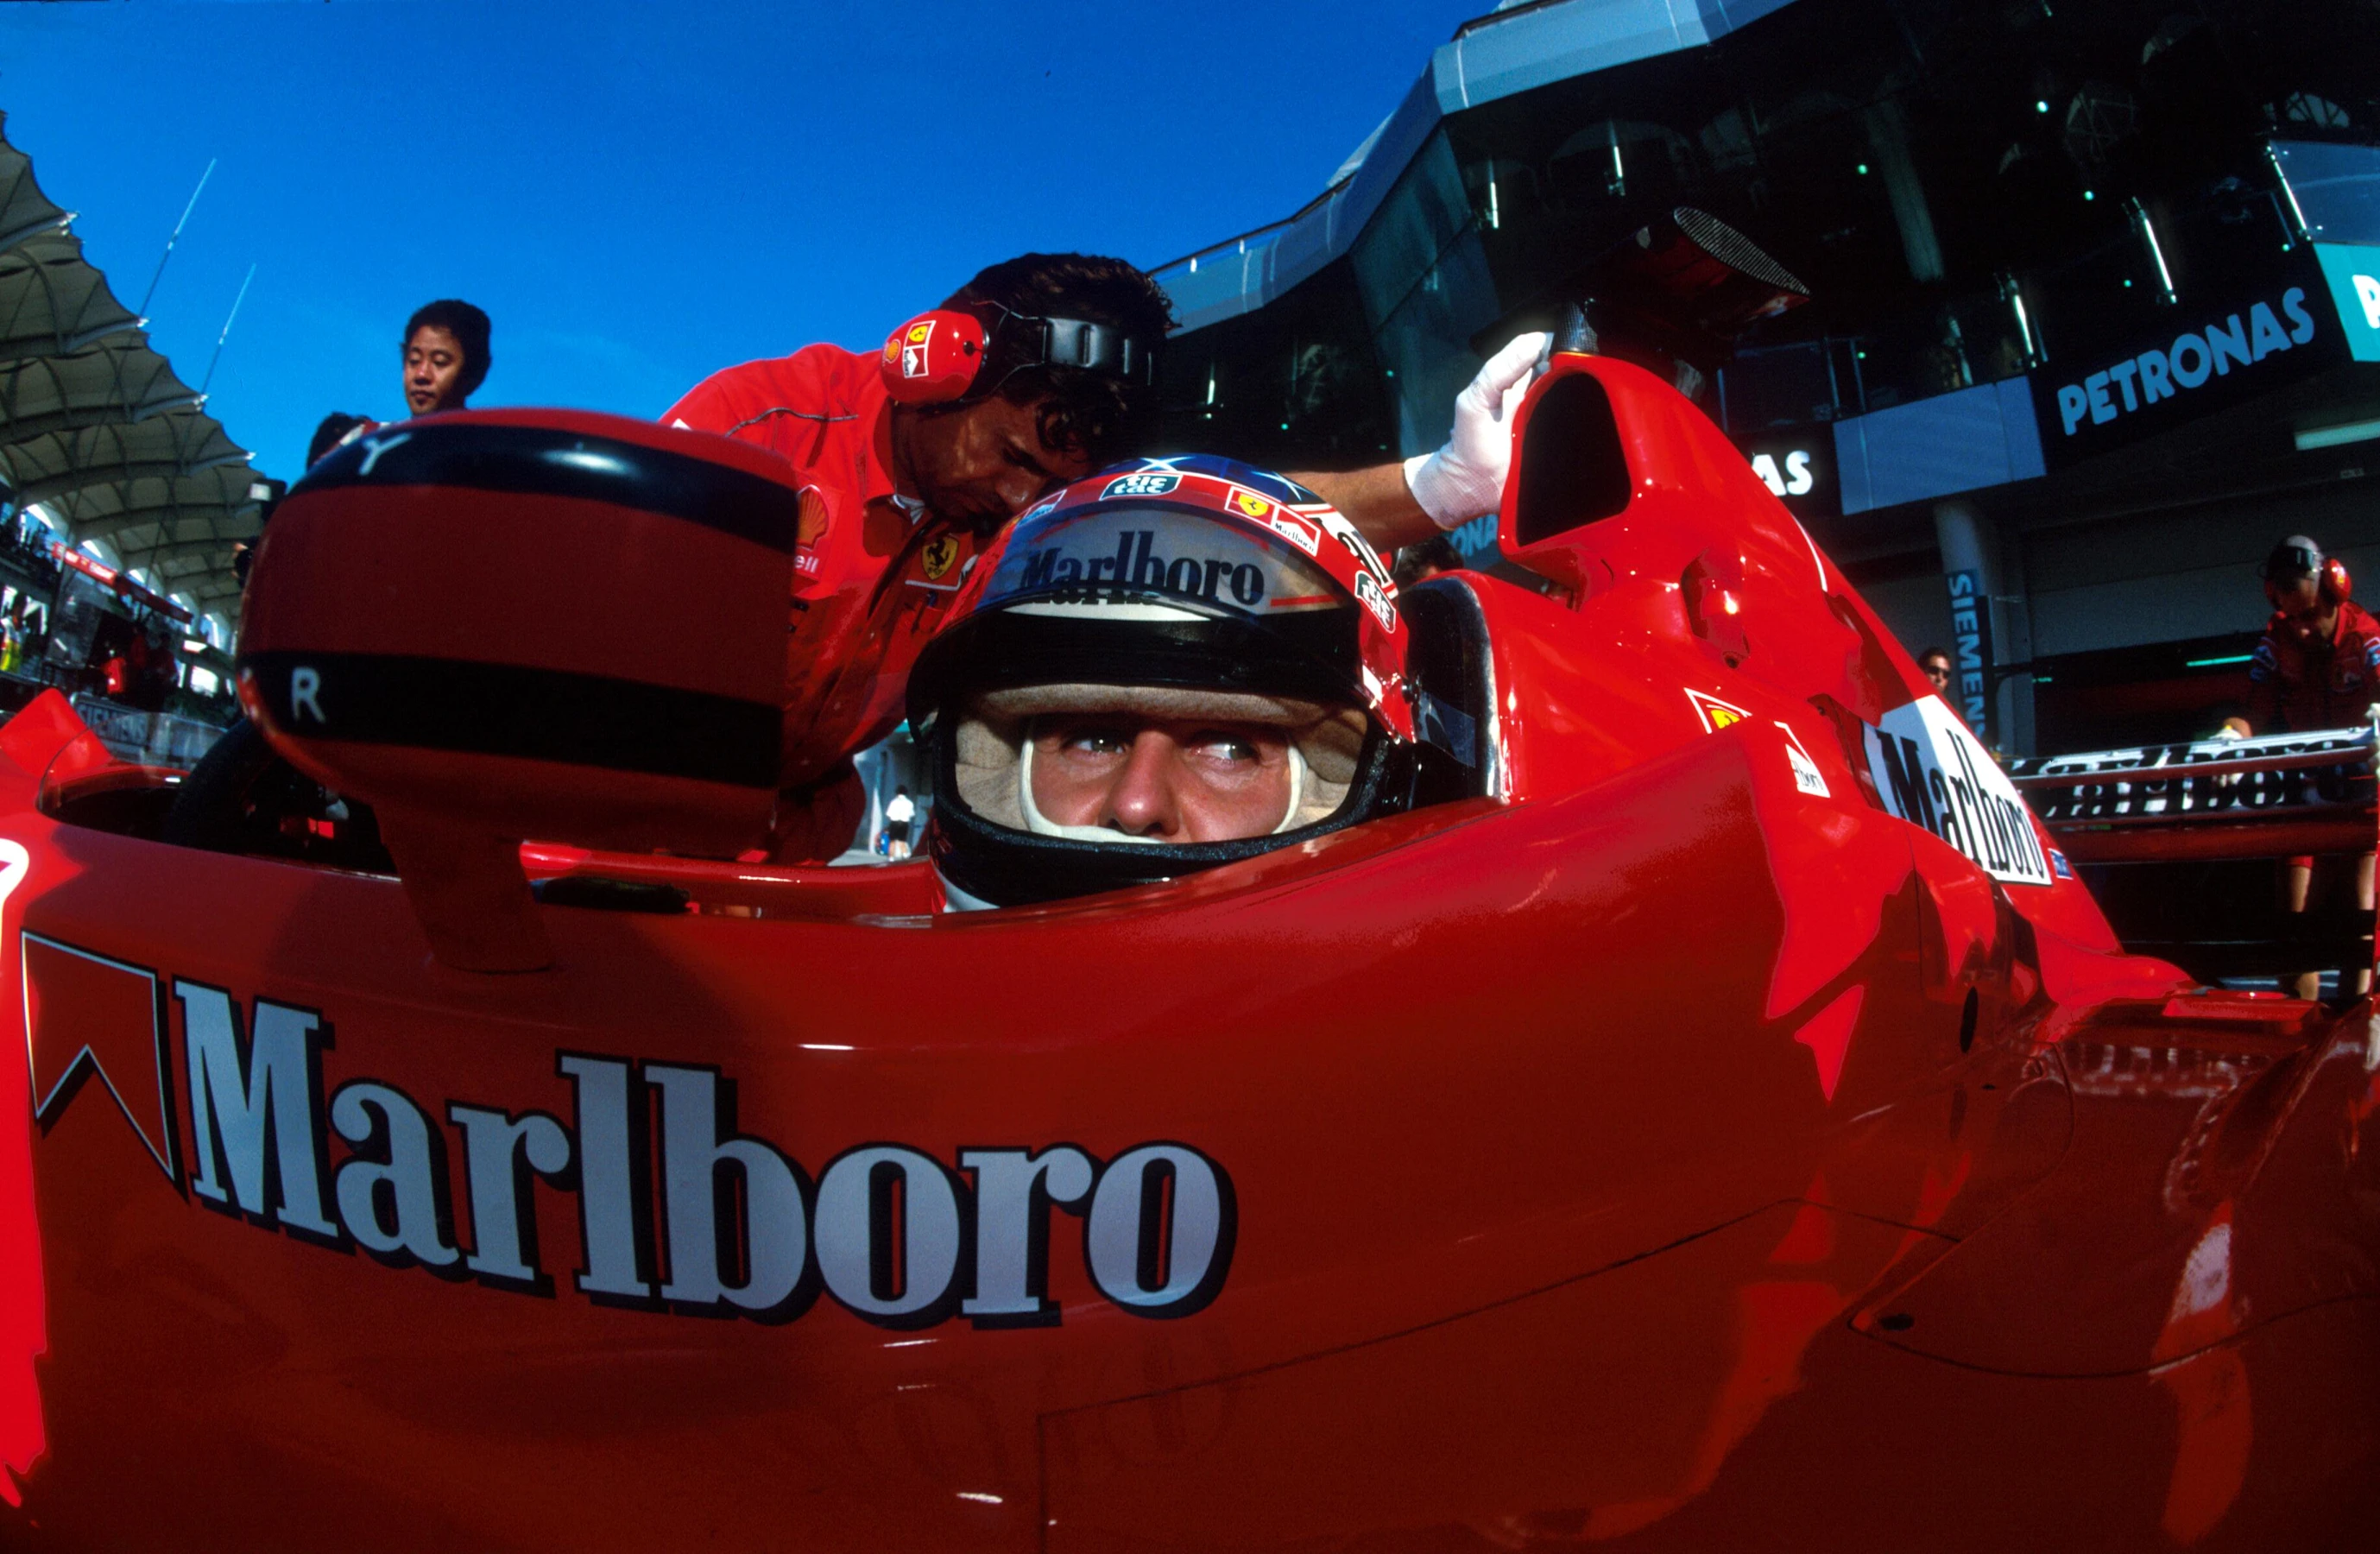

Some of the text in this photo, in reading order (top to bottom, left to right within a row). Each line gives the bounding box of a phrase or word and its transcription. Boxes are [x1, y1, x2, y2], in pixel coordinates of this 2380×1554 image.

[2058, 287, 2315, 436] PETRONAS
[358, 432, 413, 477] Y
[1114, 483, 1162, 495] tac
[1127, 474, 1167, 487] tic
[1275, 521, 1315, 553] Marlboro
[794, 554, 819, 573] ell
[1019, 529, 1266, 606] Marlboro
[291, 666, 326, 724] R
[1874, 728, 2046, 881] Marlboro
[173, 976, 1239, 1331] Marlboro
